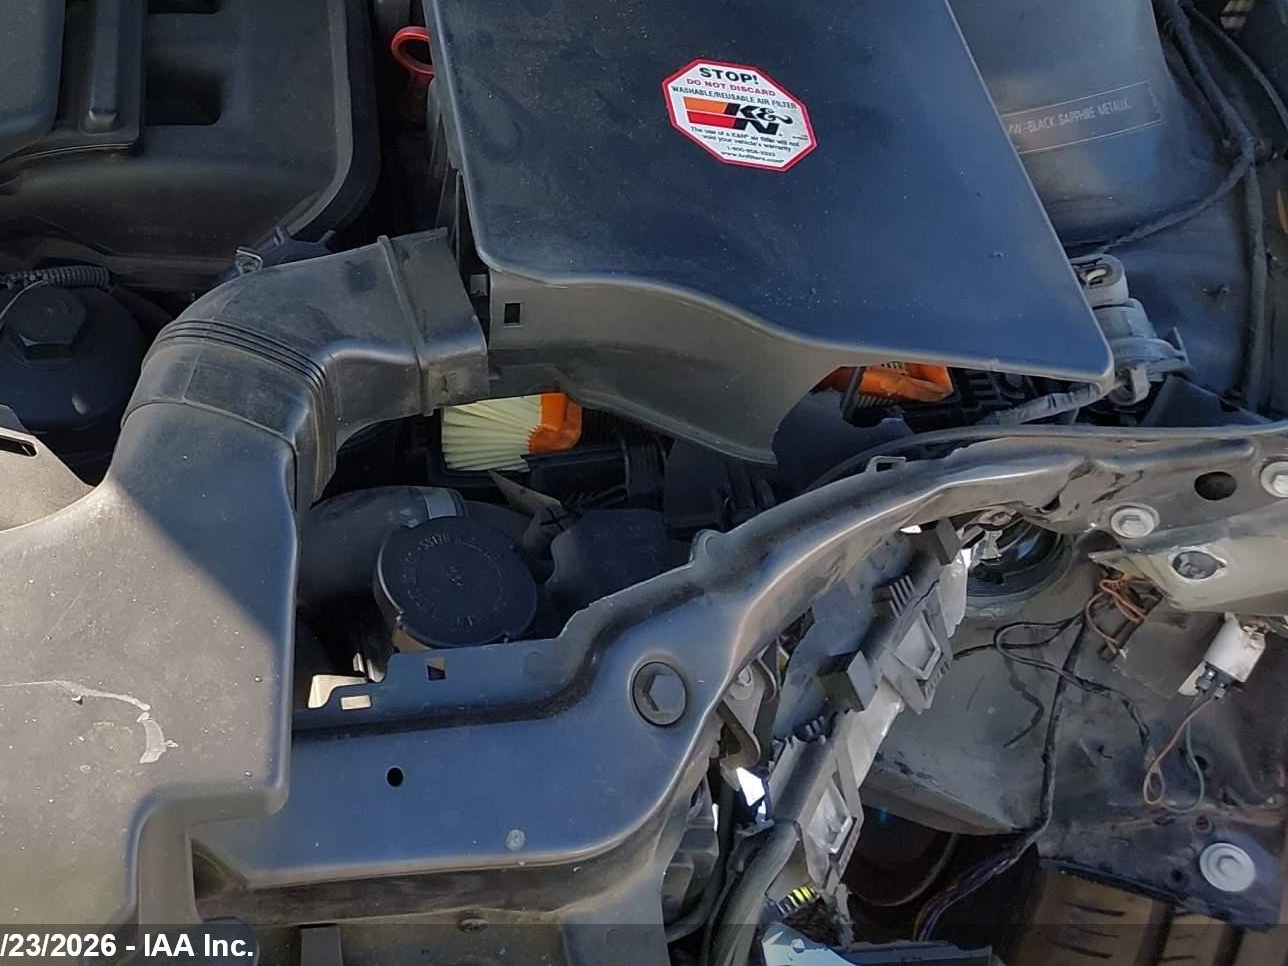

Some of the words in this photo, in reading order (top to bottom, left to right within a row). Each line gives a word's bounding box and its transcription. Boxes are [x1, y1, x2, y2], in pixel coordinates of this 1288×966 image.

[699, 67, 759, 84] STOP!
[671, 85, 755, 103] WASHABLE/REUSABLE
[757, 97, 770, 105] AIR
[772, 99, 797, 109] FILTER
[705, 81, 726, 89] NOT
[730, 84, 776, 96] DISCARD
